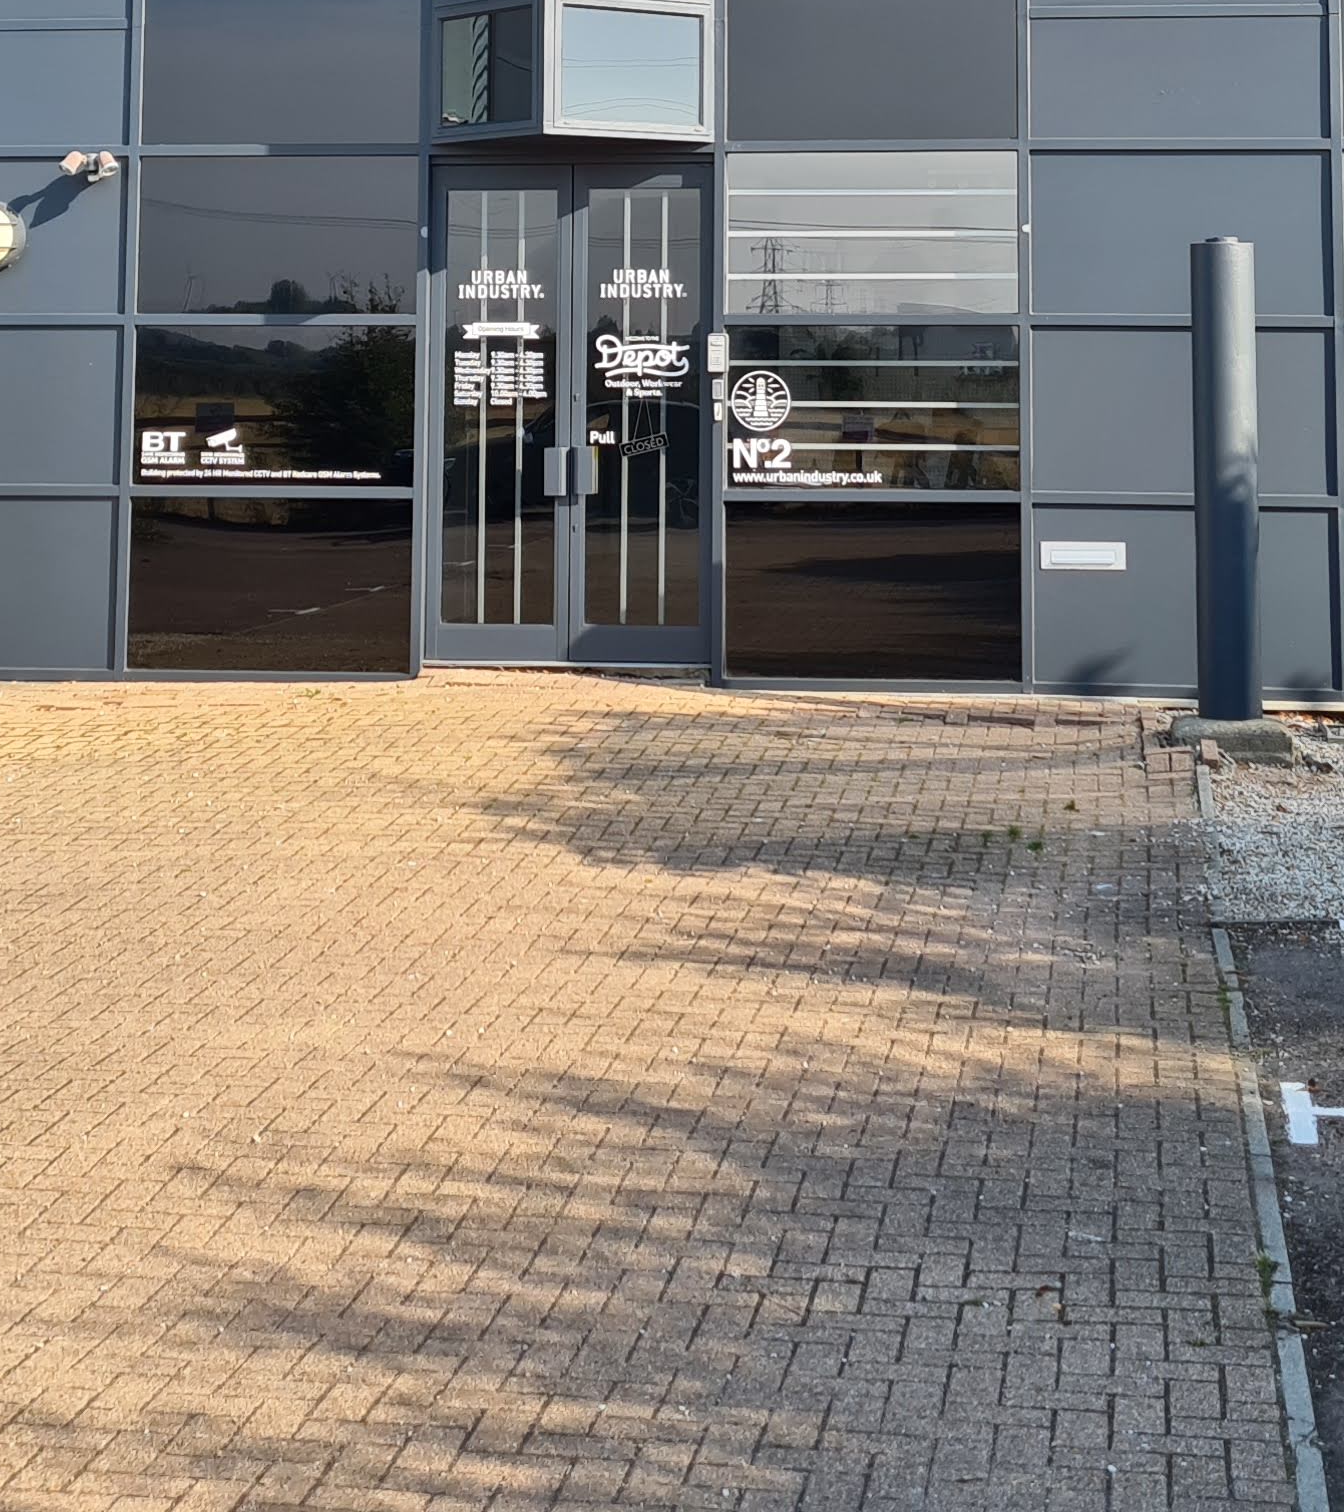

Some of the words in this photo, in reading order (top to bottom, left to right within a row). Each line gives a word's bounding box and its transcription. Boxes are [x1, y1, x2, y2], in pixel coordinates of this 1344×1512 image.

[471, 270, 527, 284] URBAN
[613, 269, 670, 284] URBAN
[478, 325, 504, 334] Opening
[505, 325, 525, 333] Hours
[455, 351, 480, 359] Monday
[594, 334, 690, 377] Depot
[454, 367, 491, 375] Wednesday
[454, 375, 485, 383] Thursday
[604, 379, 641, 388] Outdoor,
[455, 382, 475, 390] Friday
[454, 390, 483, 398] Saturday
[454, 398, 478, 406] Sunday
[142, 431, 187, 452] BT
[589, 431, 615, 444] Pull
[623, 437, 664, 455] CLOSED
[219, 457, 245, 465] SYSTEM
[141, 469, 166, 478] Building
[167, 469, 195, 478] protected
[196, 469, 203, 478] by
[732, 470, 883, 485] www.urbanindustry.co.uk
